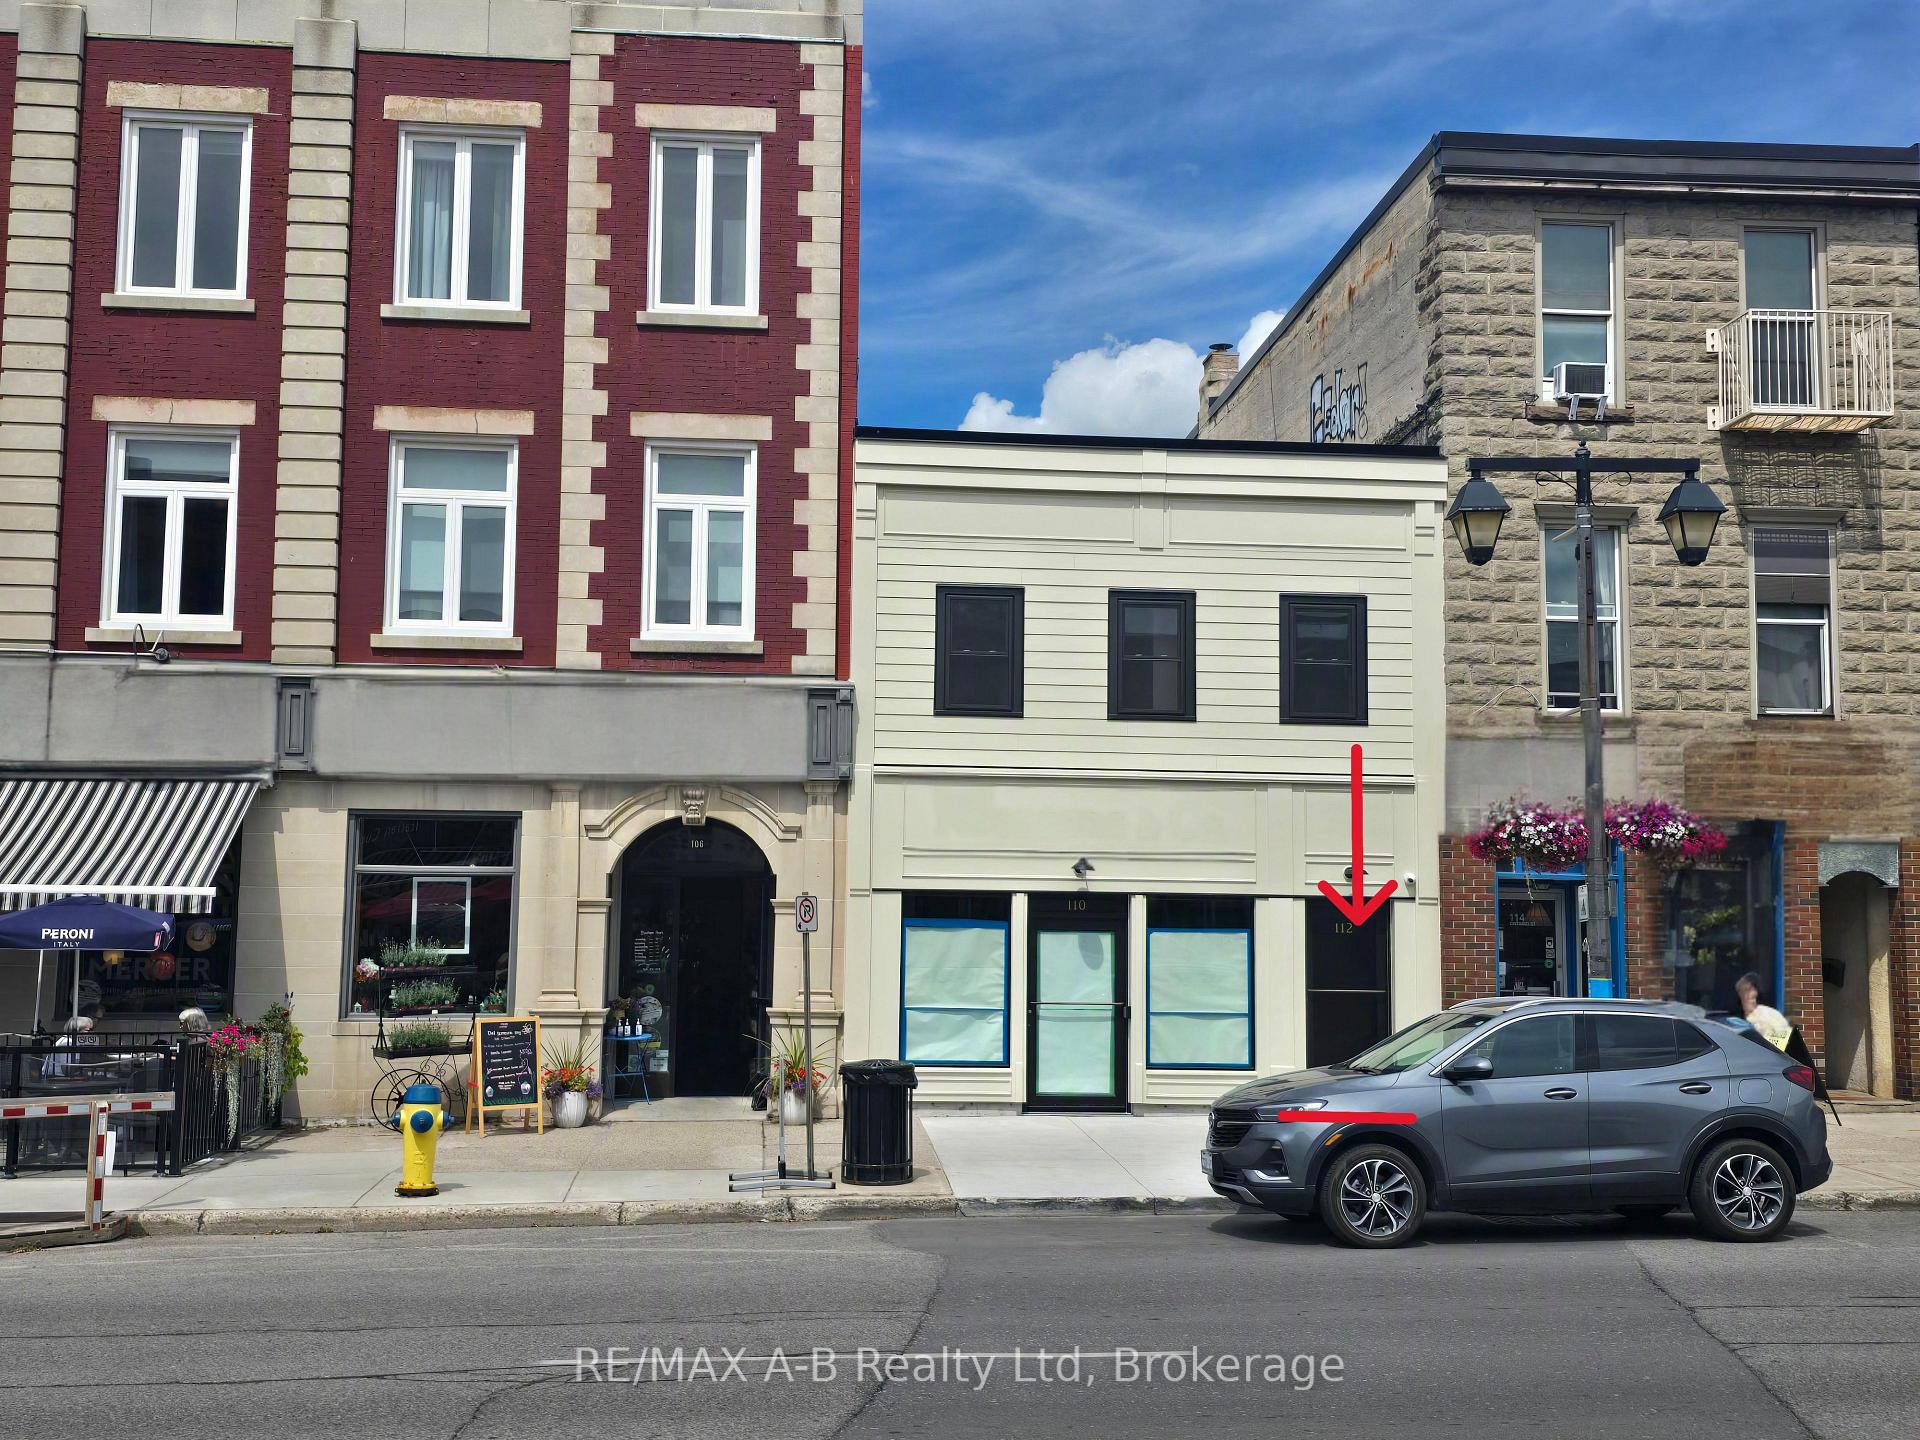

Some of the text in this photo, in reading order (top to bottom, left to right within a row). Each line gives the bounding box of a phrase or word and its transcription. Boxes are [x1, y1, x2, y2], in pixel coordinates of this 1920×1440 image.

[691, 839, 704, 849] 106
[1068, 899, 1086, 911] 110
[1509, 913, 1525, 922] 114
[41, 928, 95, 940] PERONI
[1335, 922, 1353, 934] 112
